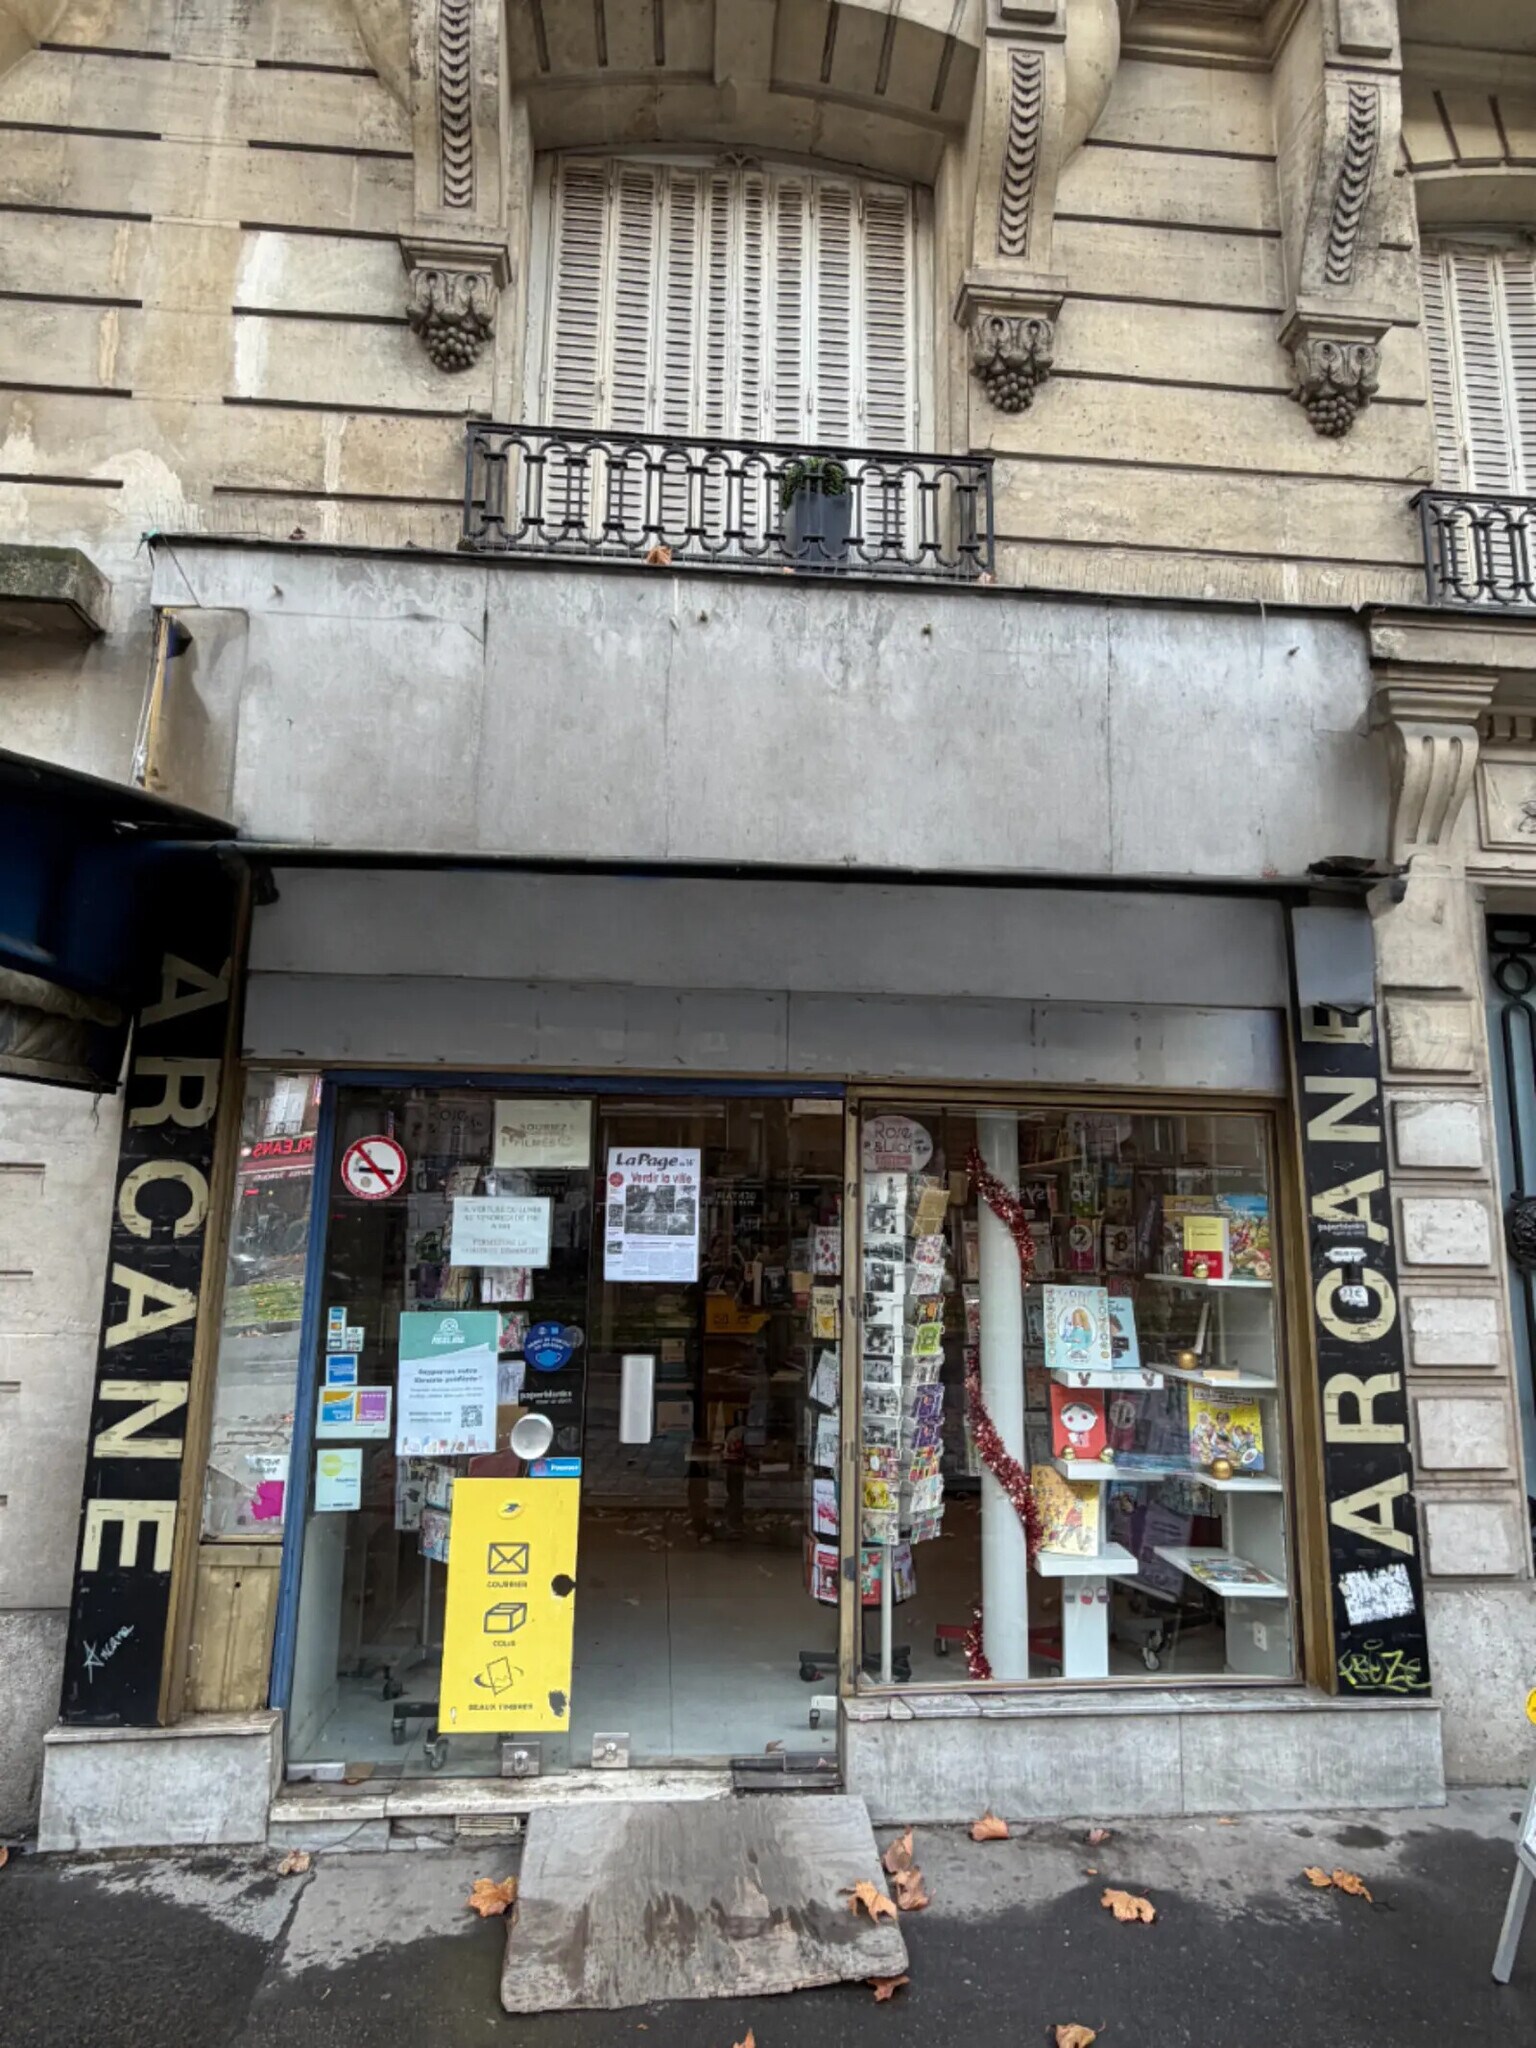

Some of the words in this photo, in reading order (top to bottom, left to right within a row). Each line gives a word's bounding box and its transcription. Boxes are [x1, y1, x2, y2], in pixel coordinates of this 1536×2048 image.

[81, 952, 231, 1572] ARCANE
[631, 1172, 659, 1184] Verdir
[661, 1173, 670, 1184] la
[673, 1172, 692, 1184] ville
[1302, 1003, 1414, 1556] ARCANE
